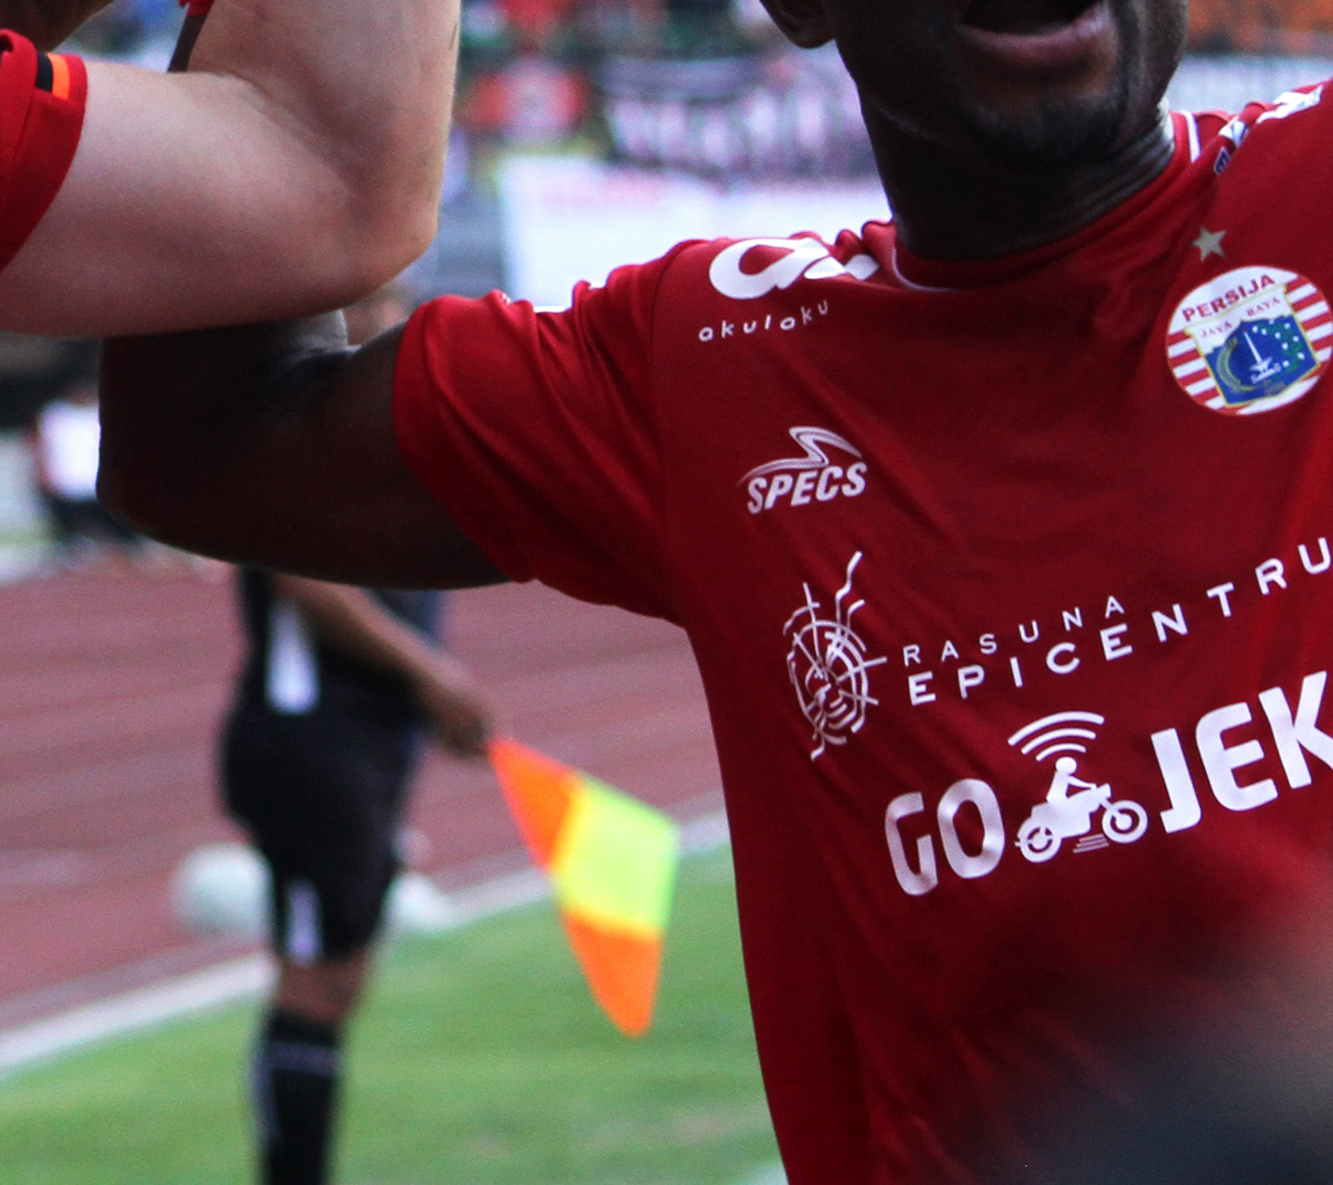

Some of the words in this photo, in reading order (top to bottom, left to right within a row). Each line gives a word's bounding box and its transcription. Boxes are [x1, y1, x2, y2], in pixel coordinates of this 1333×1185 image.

[1182, 274, 1275, 323] PERSIJA
[746, 458, 868, 515] SPECS
[903, 595, 1126, 666] RASUNA
[1150, 670, 1333, 834] JEK
